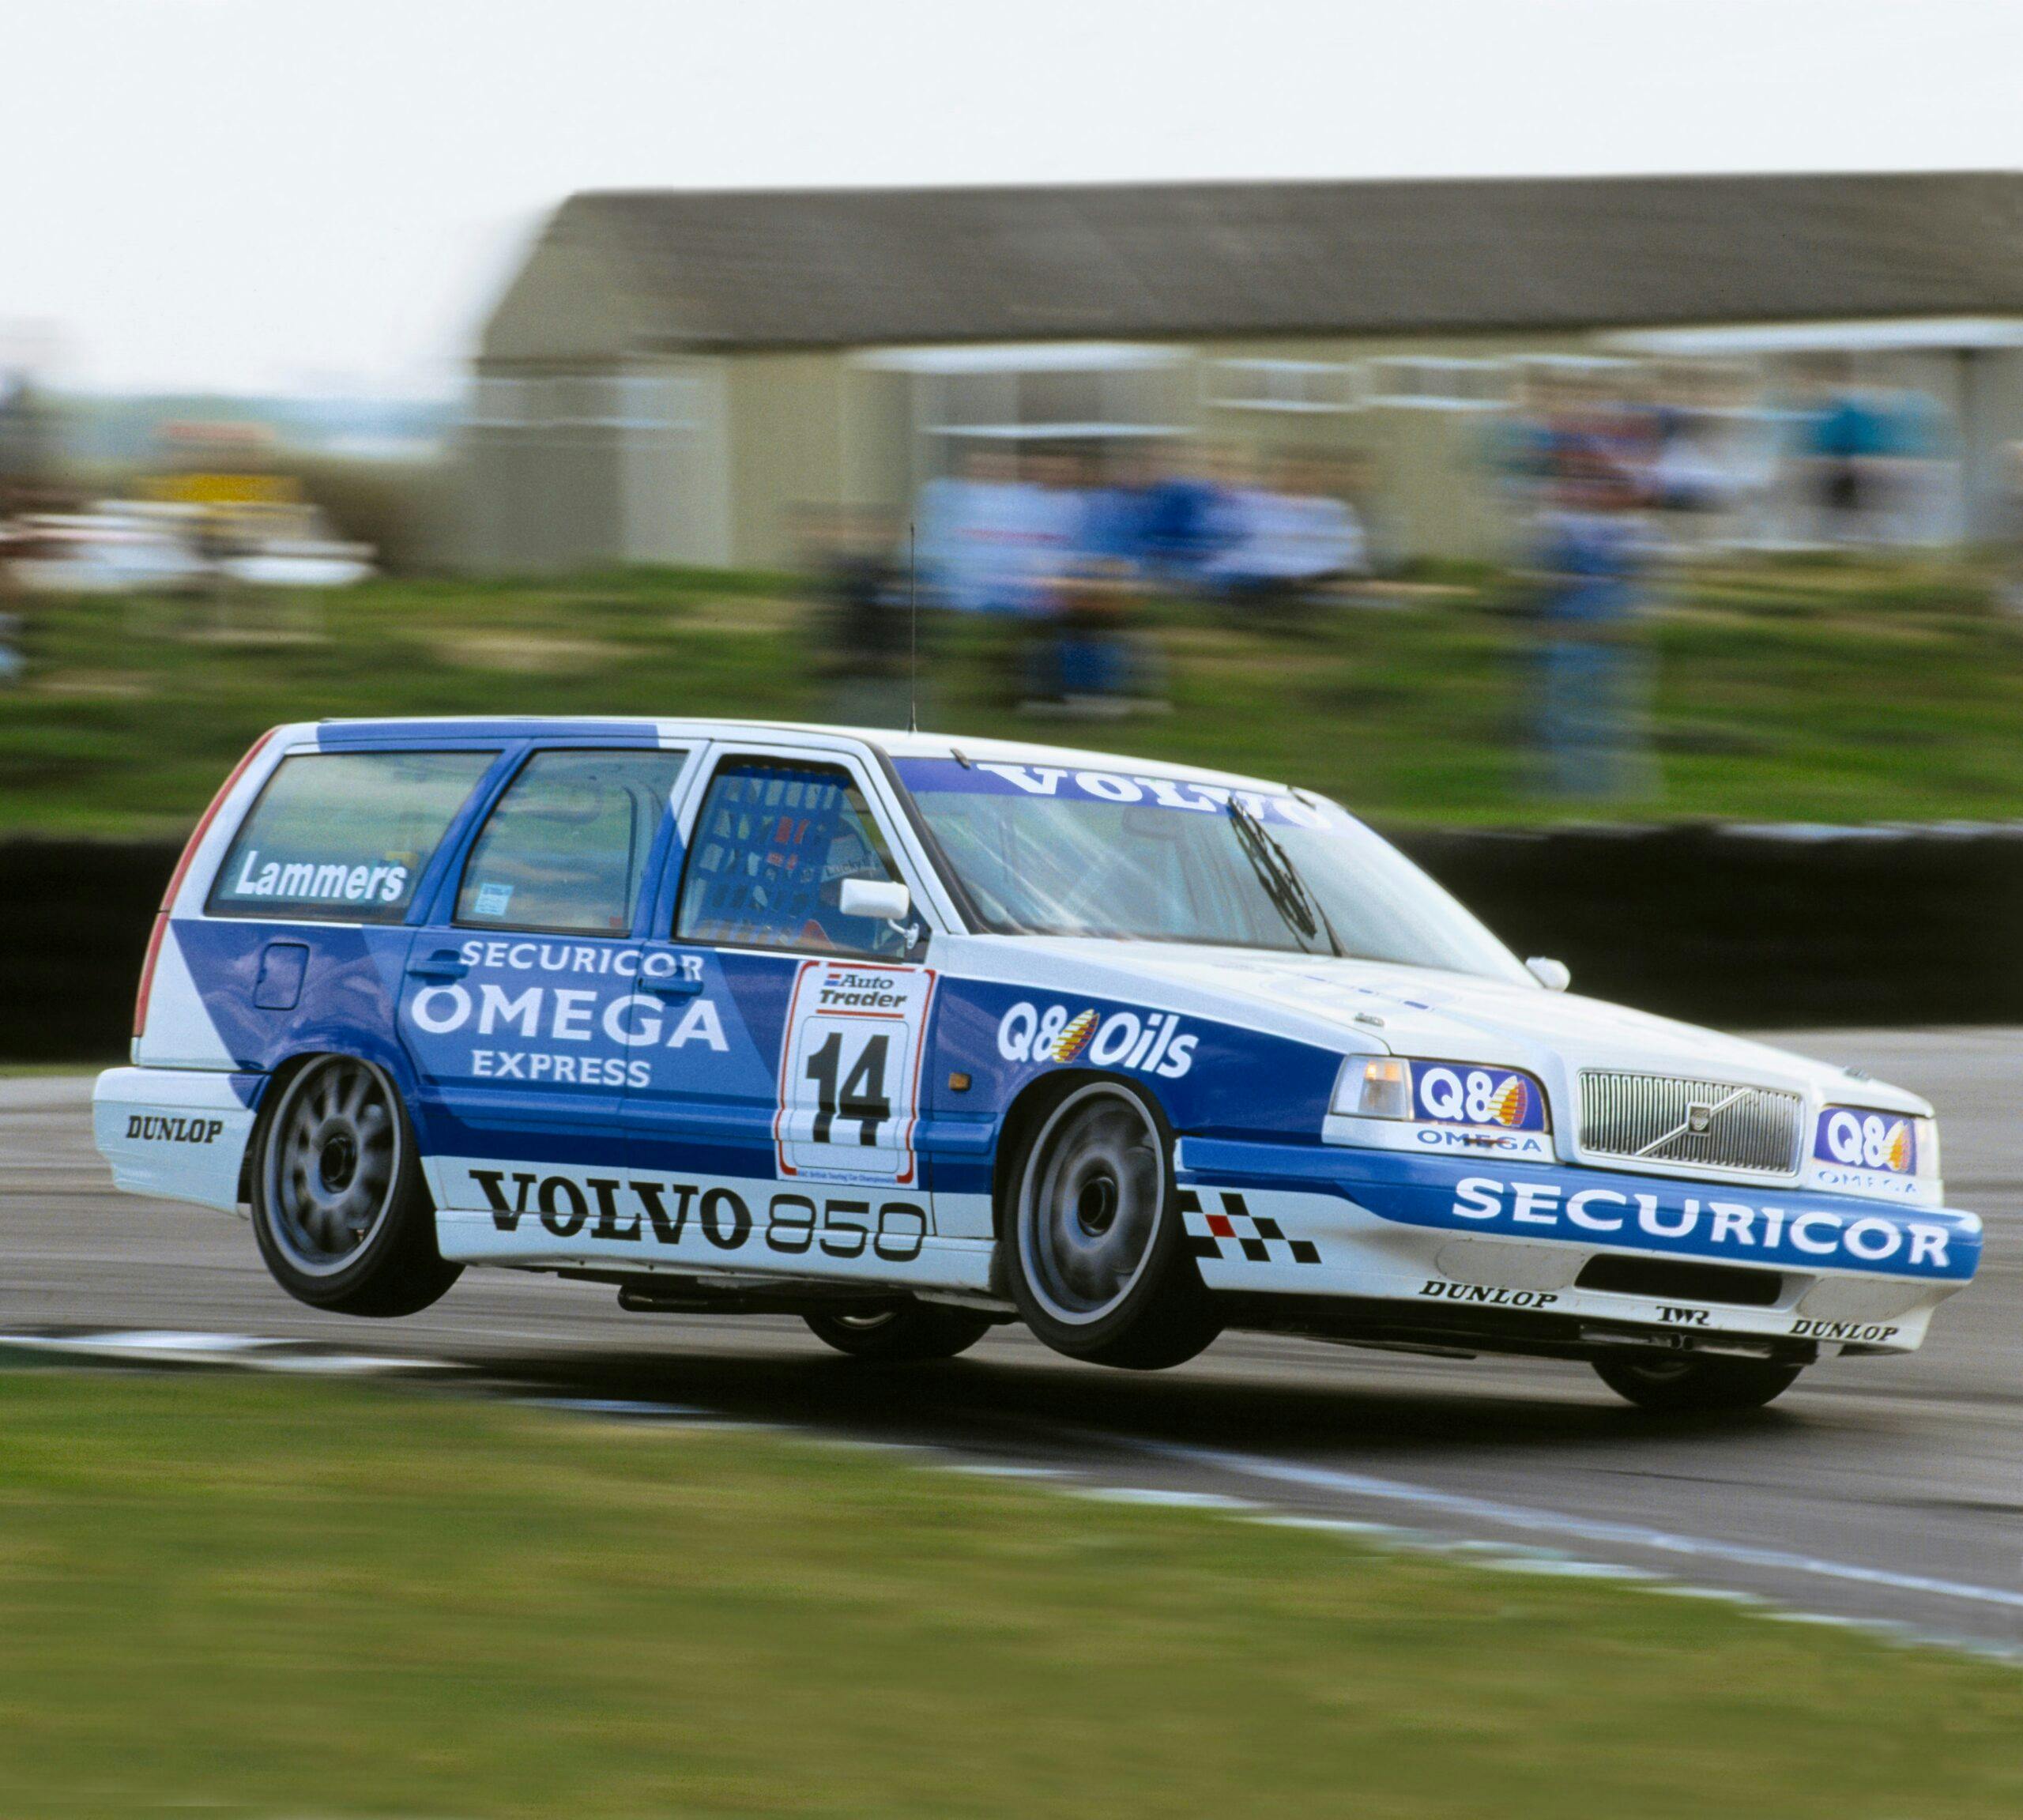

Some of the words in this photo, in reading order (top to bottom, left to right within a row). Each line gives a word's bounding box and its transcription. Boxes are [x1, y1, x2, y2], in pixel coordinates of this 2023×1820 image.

[976, 763, 1333, 830] VOLVO
[235, 850, 408, 902] Lammers
[460, 940, 704, 982] SECURICOR
[839, 974, 895, 989] Auto
[411, 984, 729, 1052] OMEGA
[820, 989, 907, 1008] Trader
[997, 1001, 1068, 1062] Q8
[1089, 1012, 1200, 1079] Oils
[471, 1049, 652, 1088] EXPRESS
[806, 1031, 891, 1147] 14
[1420, 1068, 1494, 1123] Q8
[126, 1115, 224, 1144] DUNLOP
[1417, 1129, 1543, 1153] OMEGA
[1827, 1111, 1885, 1167] Q8
[469, 1170, 753, 1250] VOLVO
[765, 1193, 928, 1262] 850
[1452, 1178, 1951, 1268] SECURICOR
[1418, 1280, 1559, 1309] DUNLOP
[1655, 1306, 1711, 1326] TWR
[1788, 1319, 1900, 1343] DUNLOP
